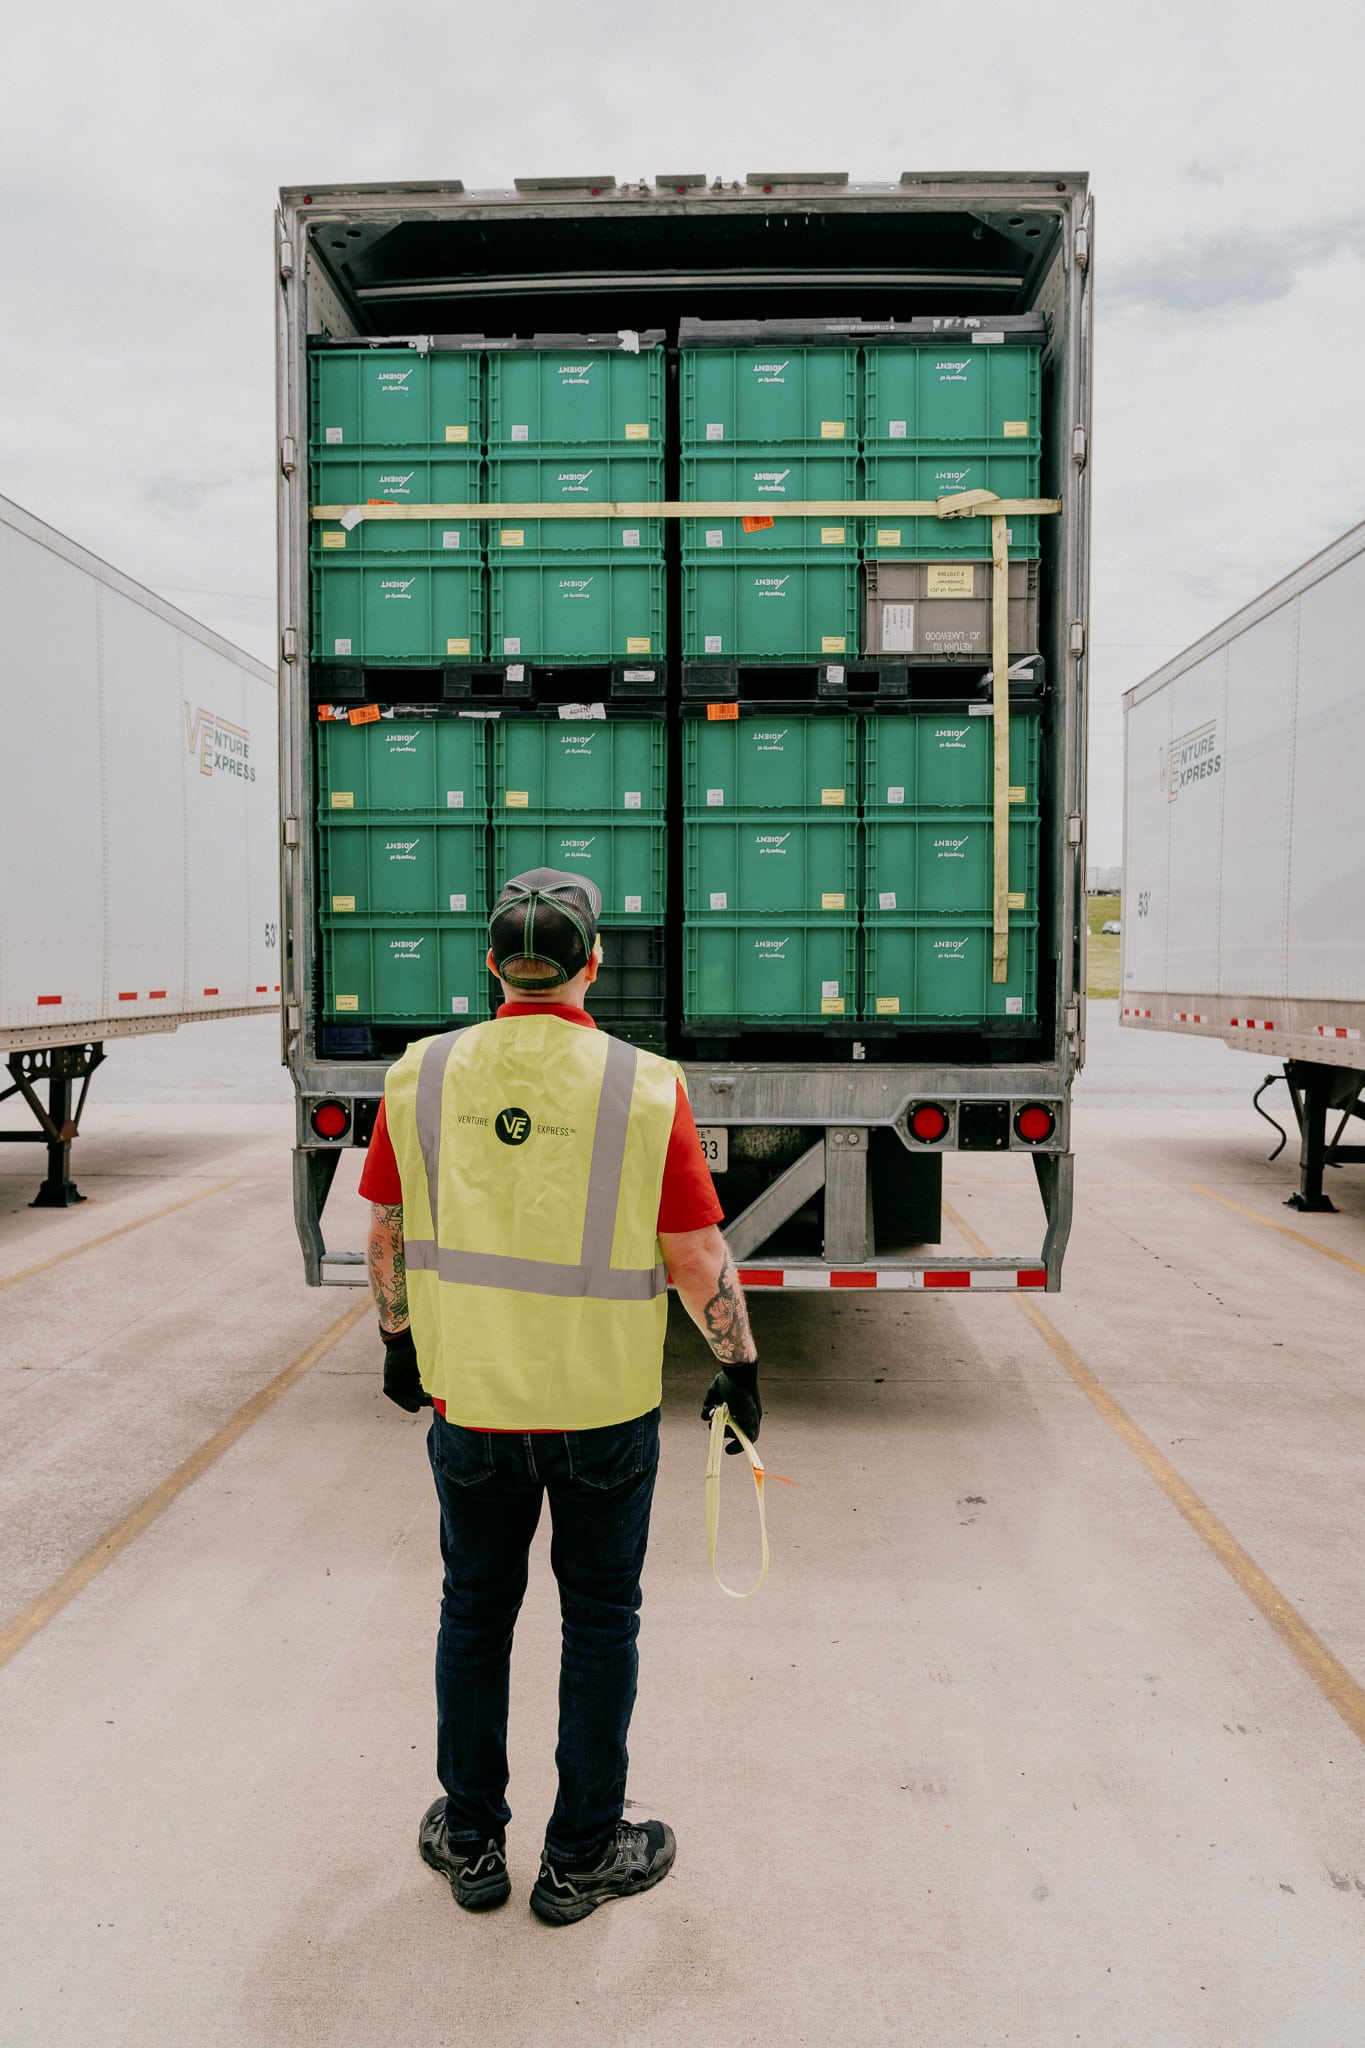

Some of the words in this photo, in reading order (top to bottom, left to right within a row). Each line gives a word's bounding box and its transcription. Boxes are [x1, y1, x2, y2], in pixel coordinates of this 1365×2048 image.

[558, 362, 593, 377] ADIENT
[753, 361, 789, 376] ADIENT
[936, 359, 971, 373] ADIENT
[378, 369, 413, 384] ADIENT
[379, 472, 414, 487] ADIENT
[558, 470, 592, 484] ADIENT
[935, 468, 970, 483] ADIENT
[380, 578, 415, 592] ADIENT
[559, 577, 593, 591] ADIENT
[754, 575, 789, 589] ADIENT
[925, 631, 964, 641] LAKEWOOD
[969, 631, 980, 641] JCI
[933, 642, 944, 652] TO
[944, 642, 972, 652] RETURN
[385, 731, 419, 745] ADIENT
[561, 733, 595, 747] ADIENT
[753, 730, 788, 744] ADIENT
[935, 726, 970, 741] ADIENT
[385, 839, 419, 853] ADIENT
[561, 837, 595, 851] ADIENT
[755, 833, 790, 847] ADIENT
[933, 836, 968, 850] ADIENT
[390, 938, 424, 952] ADIENT
[754, 938, 789, 951] ADIENT
[934, 937, 968, 951] ADIENT
[458, 1115, 489, 1127] VENTURE
[502, 1114, 528, 1140] VE
[537, 1124, 569, 1137] EXPRESS
